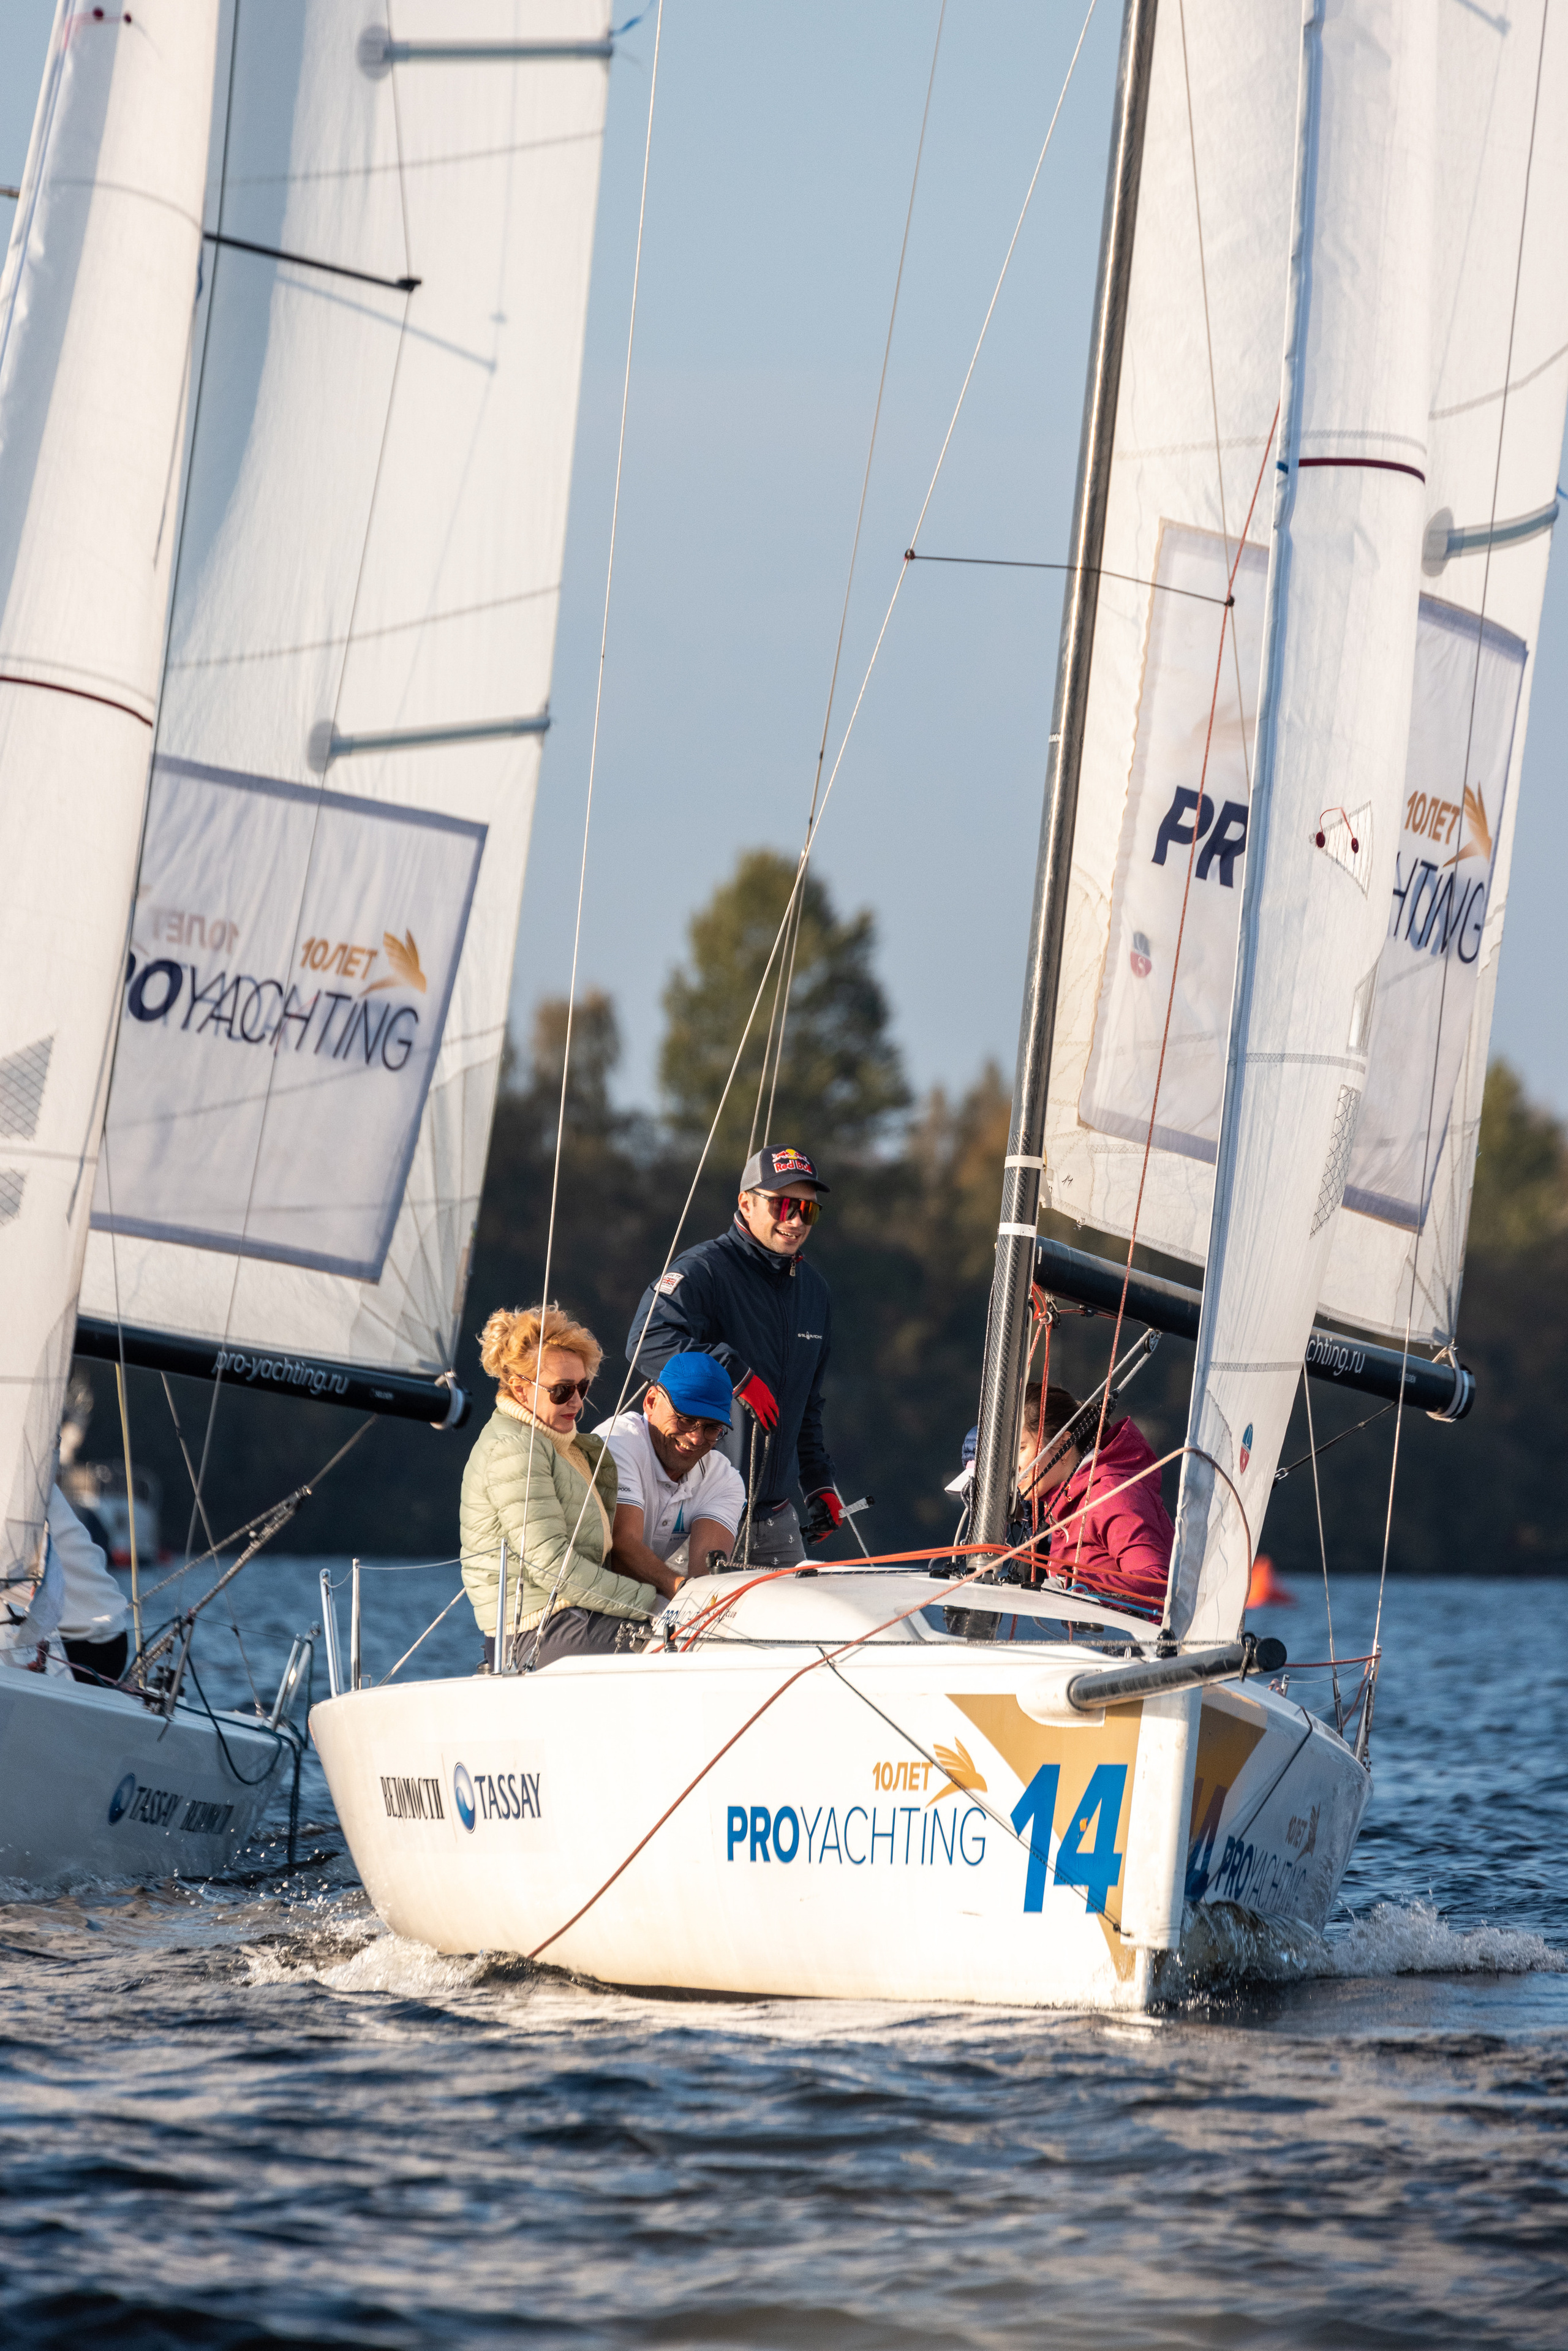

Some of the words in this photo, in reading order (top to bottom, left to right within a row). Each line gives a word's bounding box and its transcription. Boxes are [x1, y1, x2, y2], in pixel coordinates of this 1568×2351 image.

[125, 951, 420, 1071] OYACHTING
[774, 1159, 796, 1173] Red
[795, 1160, 813, 1174] Bull
[211, 1350, 349, 1395] pro-yachting.ru
[129, 1785, 184, 1828] TASSAY
[473, 1773, 543, 1820] TASSAY
[726, 1805, 987, 1866] PROYACHTING
[1010, 1764, 1128, 1914] 14
